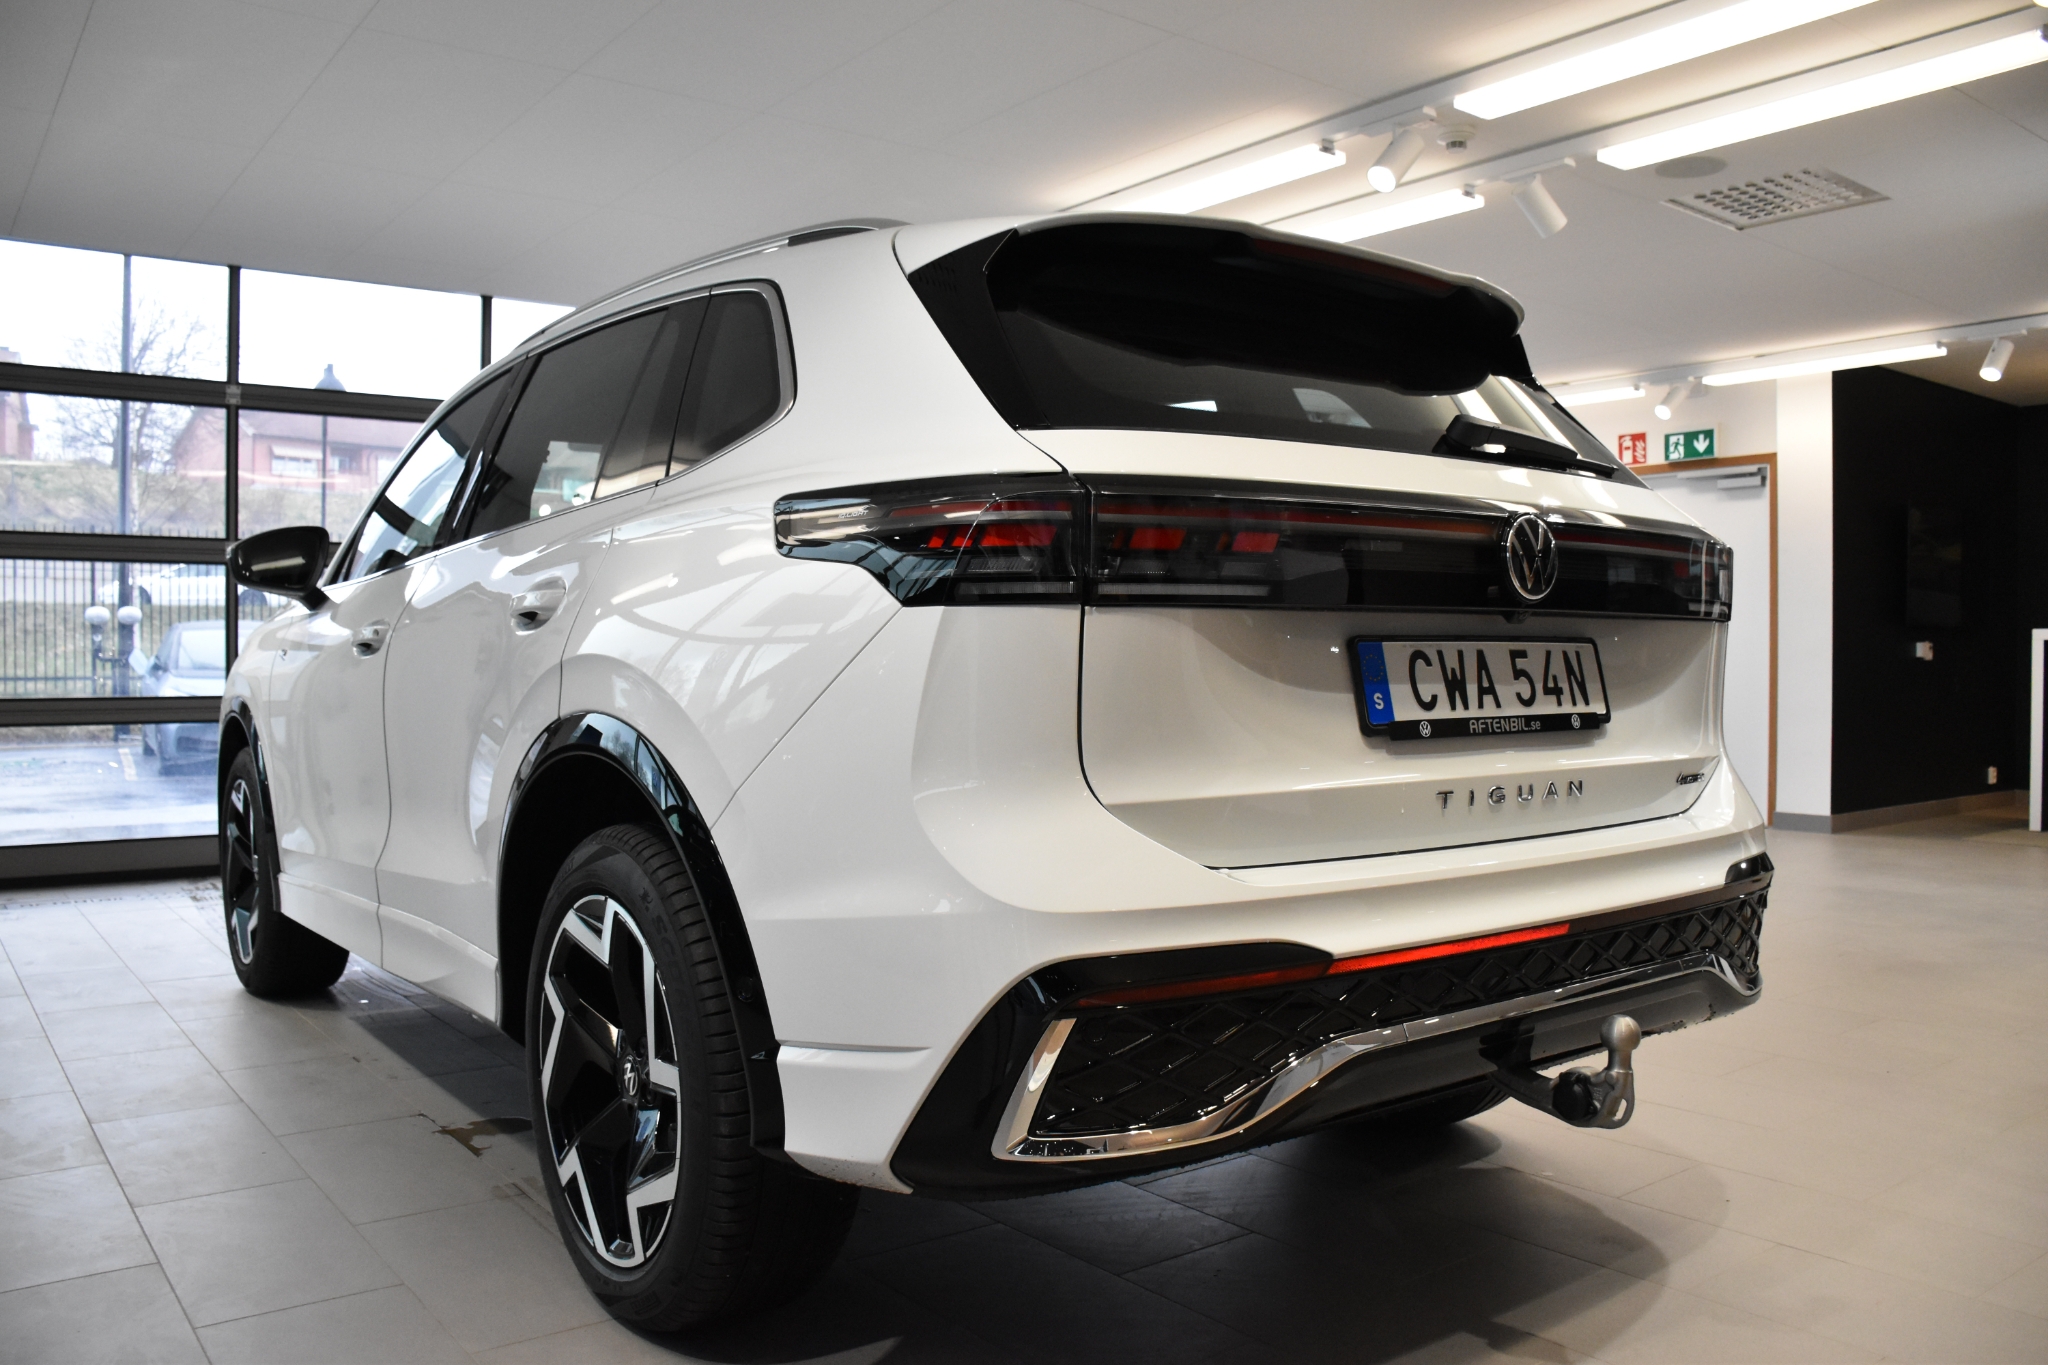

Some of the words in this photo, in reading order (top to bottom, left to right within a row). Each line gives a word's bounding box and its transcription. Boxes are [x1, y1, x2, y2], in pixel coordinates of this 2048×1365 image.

[1408, 649, 1502, 712] CWA
[1508, 649, 1590, 708] 54N
[1373, 692, 1384, 710] S
[1469, 716, 1541, 734] AFTENBIL.se
[1436, 779, 1583, 810] TIGUAN
